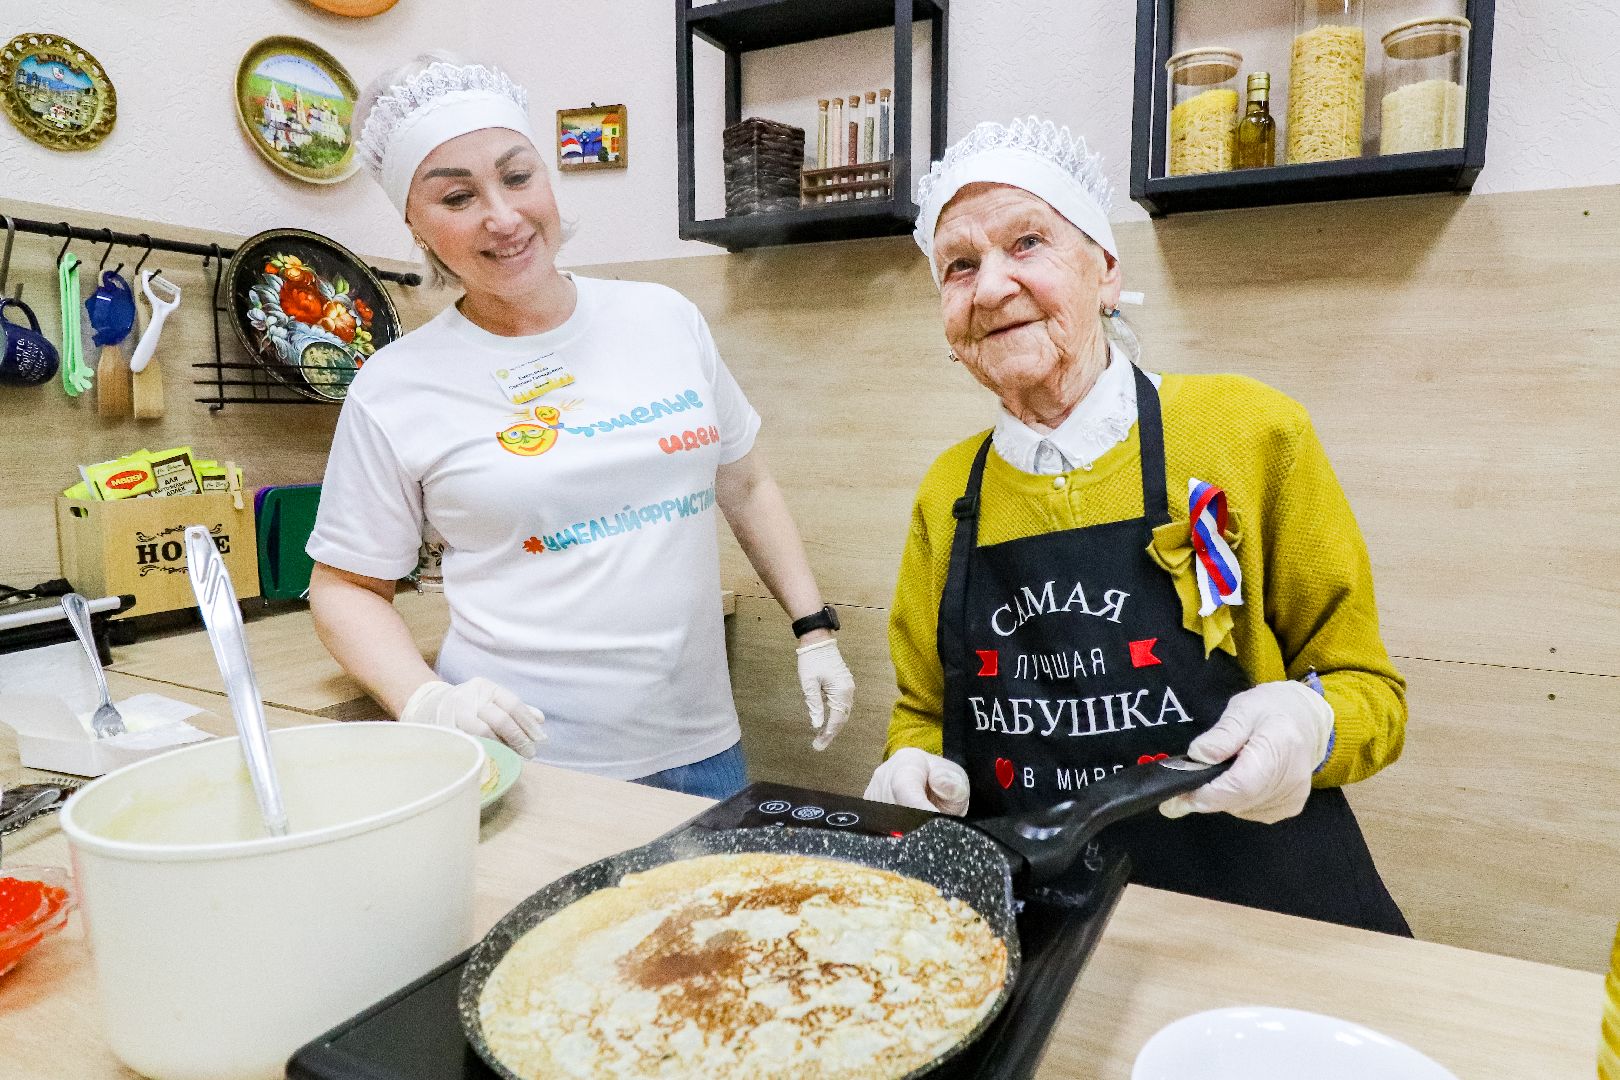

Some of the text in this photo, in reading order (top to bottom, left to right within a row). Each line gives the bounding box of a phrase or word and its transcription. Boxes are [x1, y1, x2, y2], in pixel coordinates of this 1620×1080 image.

[136, 535, 231, 565] HOE
[991, 580, 1131, 637] САМАЯ
[1013, 647, 1106, 680] ЛУЧШАЯ
[968, 685, 1194, 737] БАБУШКА
[1022, 767, 1035, 788] В
